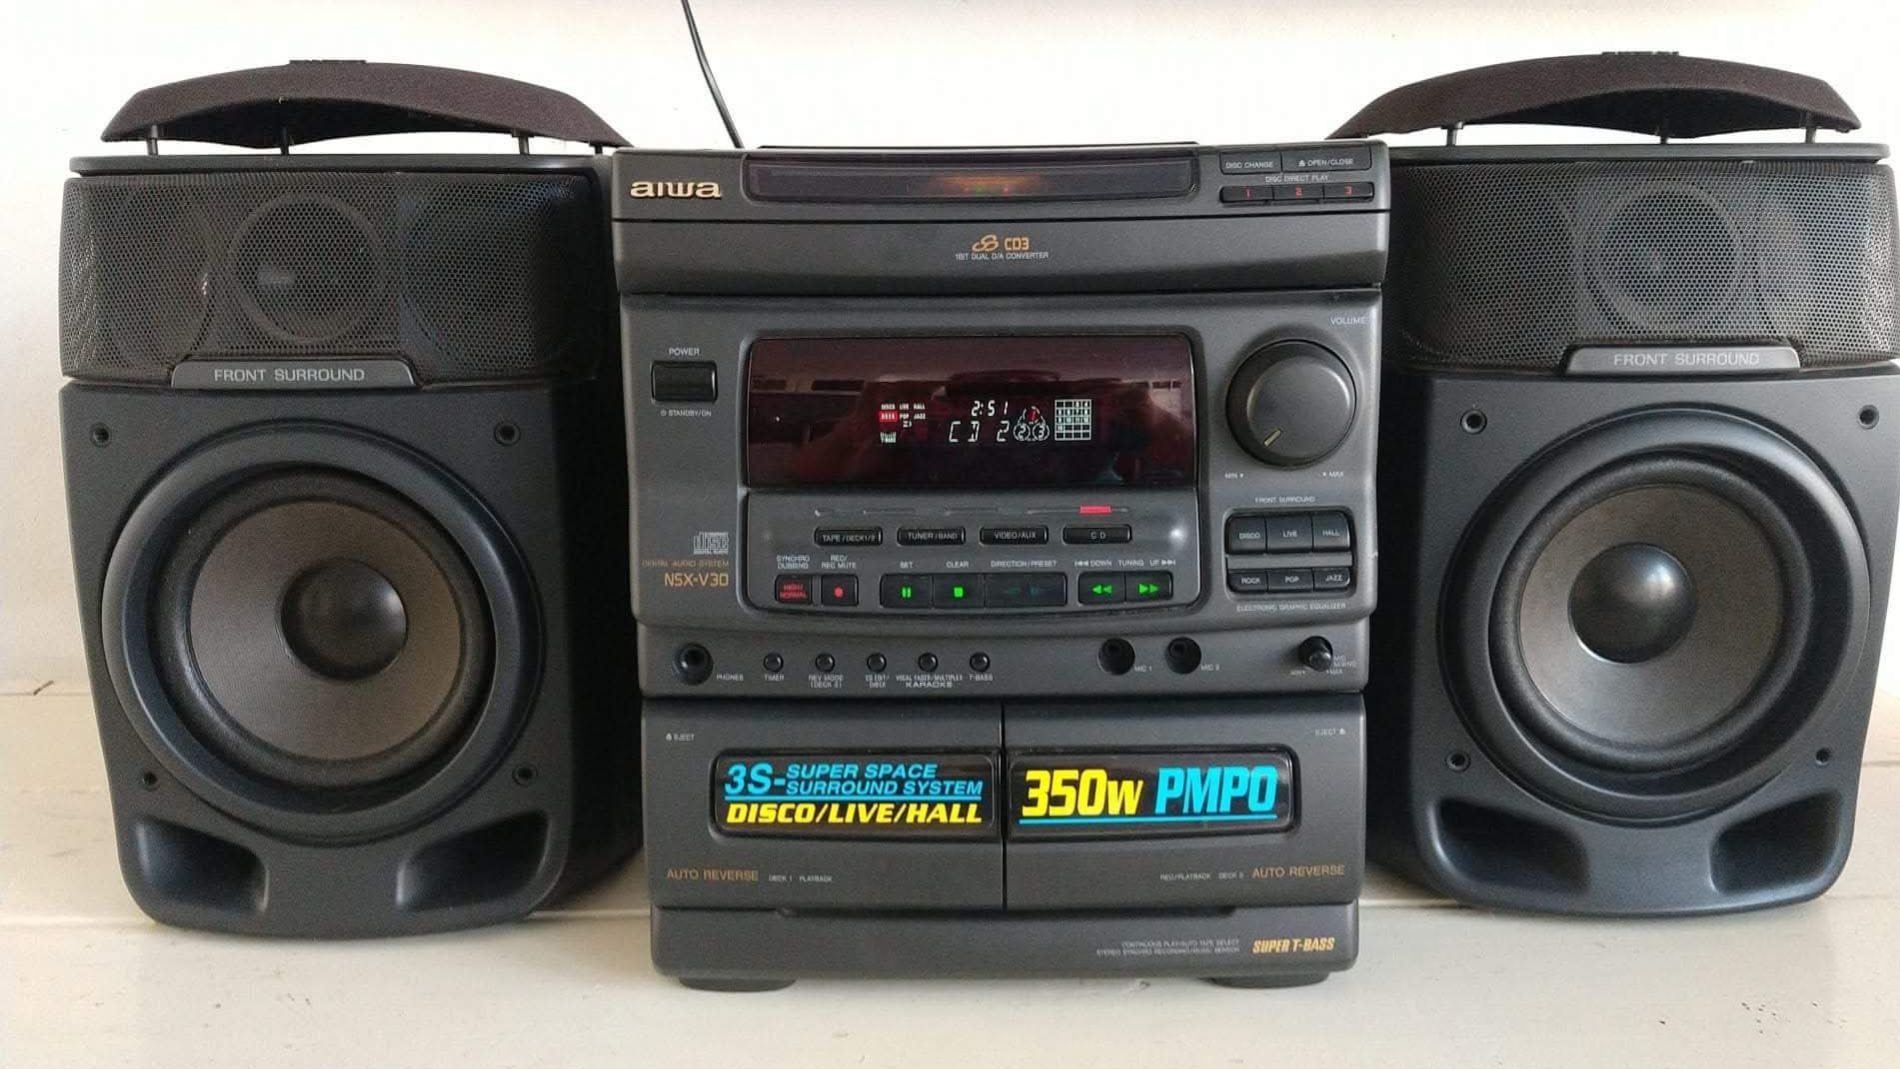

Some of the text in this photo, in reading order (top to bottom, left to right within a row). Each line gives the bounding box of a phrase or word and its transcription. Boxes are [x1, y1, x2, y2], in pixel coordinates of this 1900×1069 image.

[1308, 158, 1354, 167] OPEN/CLOSE
[630, 180, 722, 199] aiwa
[1296, 187, 1302, 196] 2
[1344, 186, 1352, 195] 3
[1004, 236, 1030, 250] CD3
[1006, 251, 1049, 260] CONVERTER
[1330, 316, 1367, 325] VOLUME
[668, 347, 700, 356] POWER
[1614, 352, 1760, 367] FRONT SURROUND
[214, 368, 366, 382] FRONT SURROUND
[970, 400, 1008, 417] 2:51
[994, 532, 1037, 540] VIDEO/AUX
[664, 572, 729, 587] NSX-V30
[786, 764, 858, 779] SUPER
[864, 764, 938, 779] SPACE
[786, 780, 983, 796] SURROUND SYSTEM
[1154, 765, 1279, 816] PMPO
[726, 802, 983, 824] DISCO/LIVE/HALL
[666, 869, 759, 882] AUTO REVERSE
[1252, 864, 1346, 879] AUTO REVERSE
[1252, 937, 1336, 954] SUPER T-BASS
